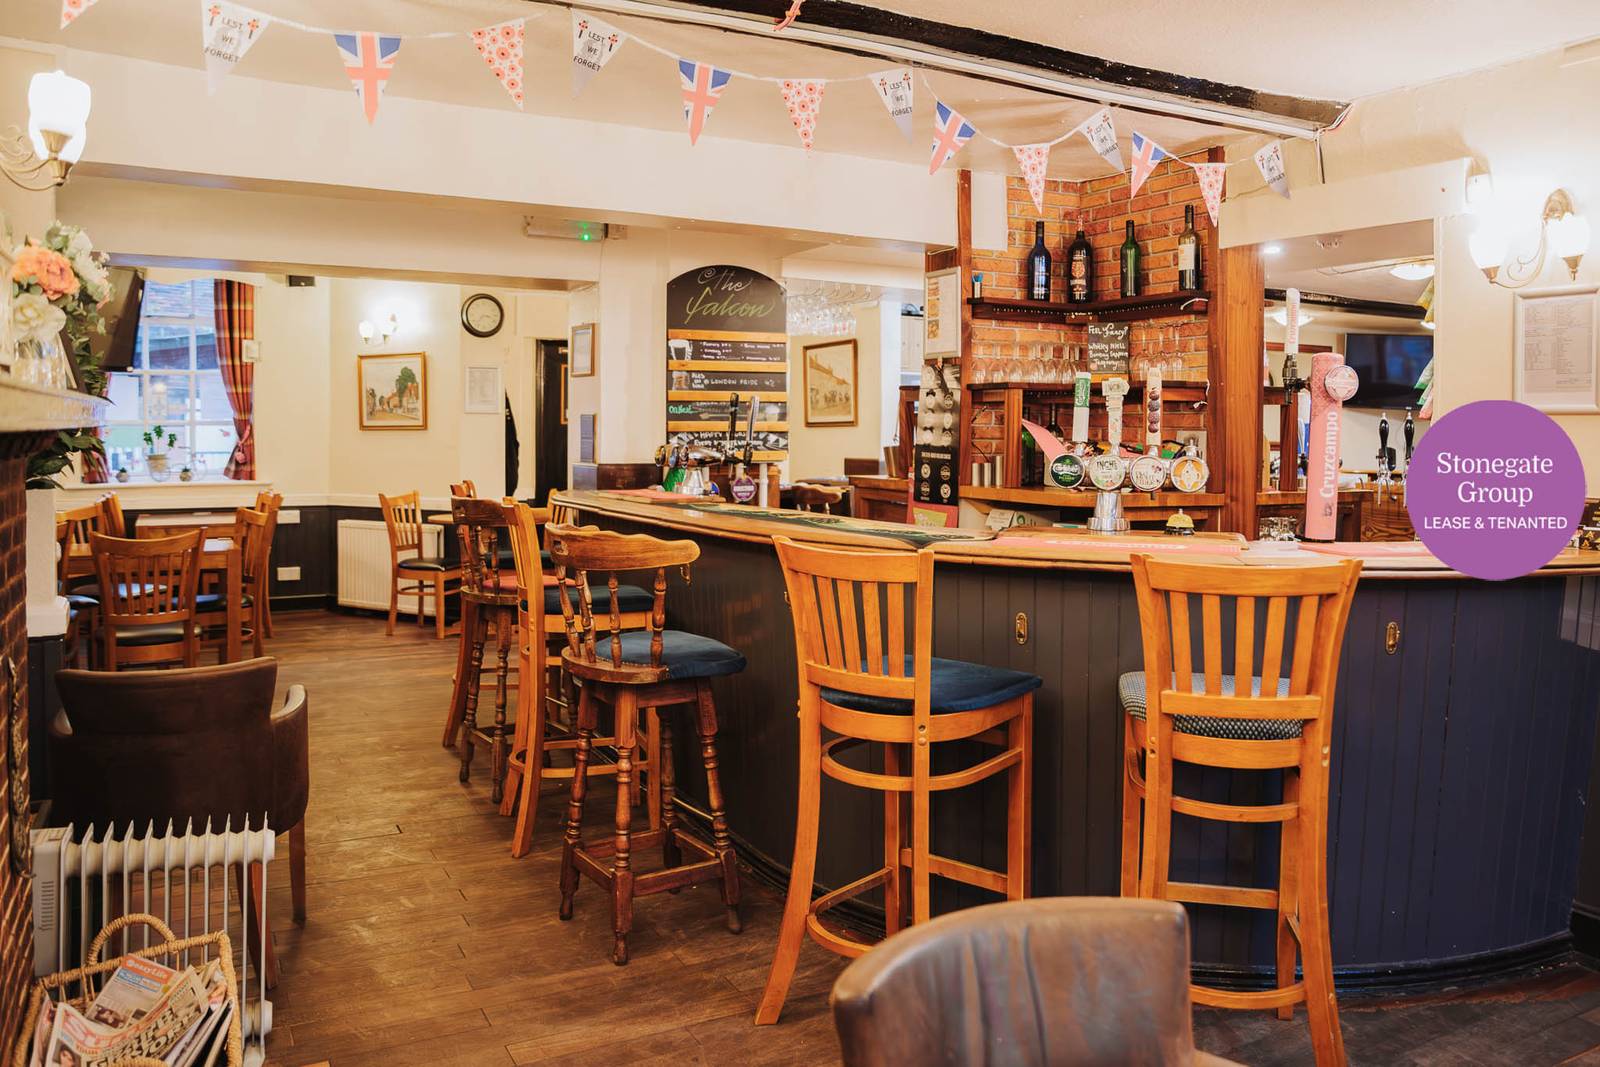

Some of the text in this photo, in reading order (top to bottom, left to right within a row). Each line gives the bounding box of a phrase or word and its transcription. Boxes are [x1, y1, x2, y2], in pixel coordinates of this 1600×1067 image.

[222, 17, 244, 30] LEST
[588, 31, 605, 43] LEST
[204, 46, 240, 63] FORGET
[587, 45, 598, 56] WE
[573, 55, 601, 72] FORGET
[697, 267, 753, 292] The
[1320, 411, 1338, 499] Cruzcampo
